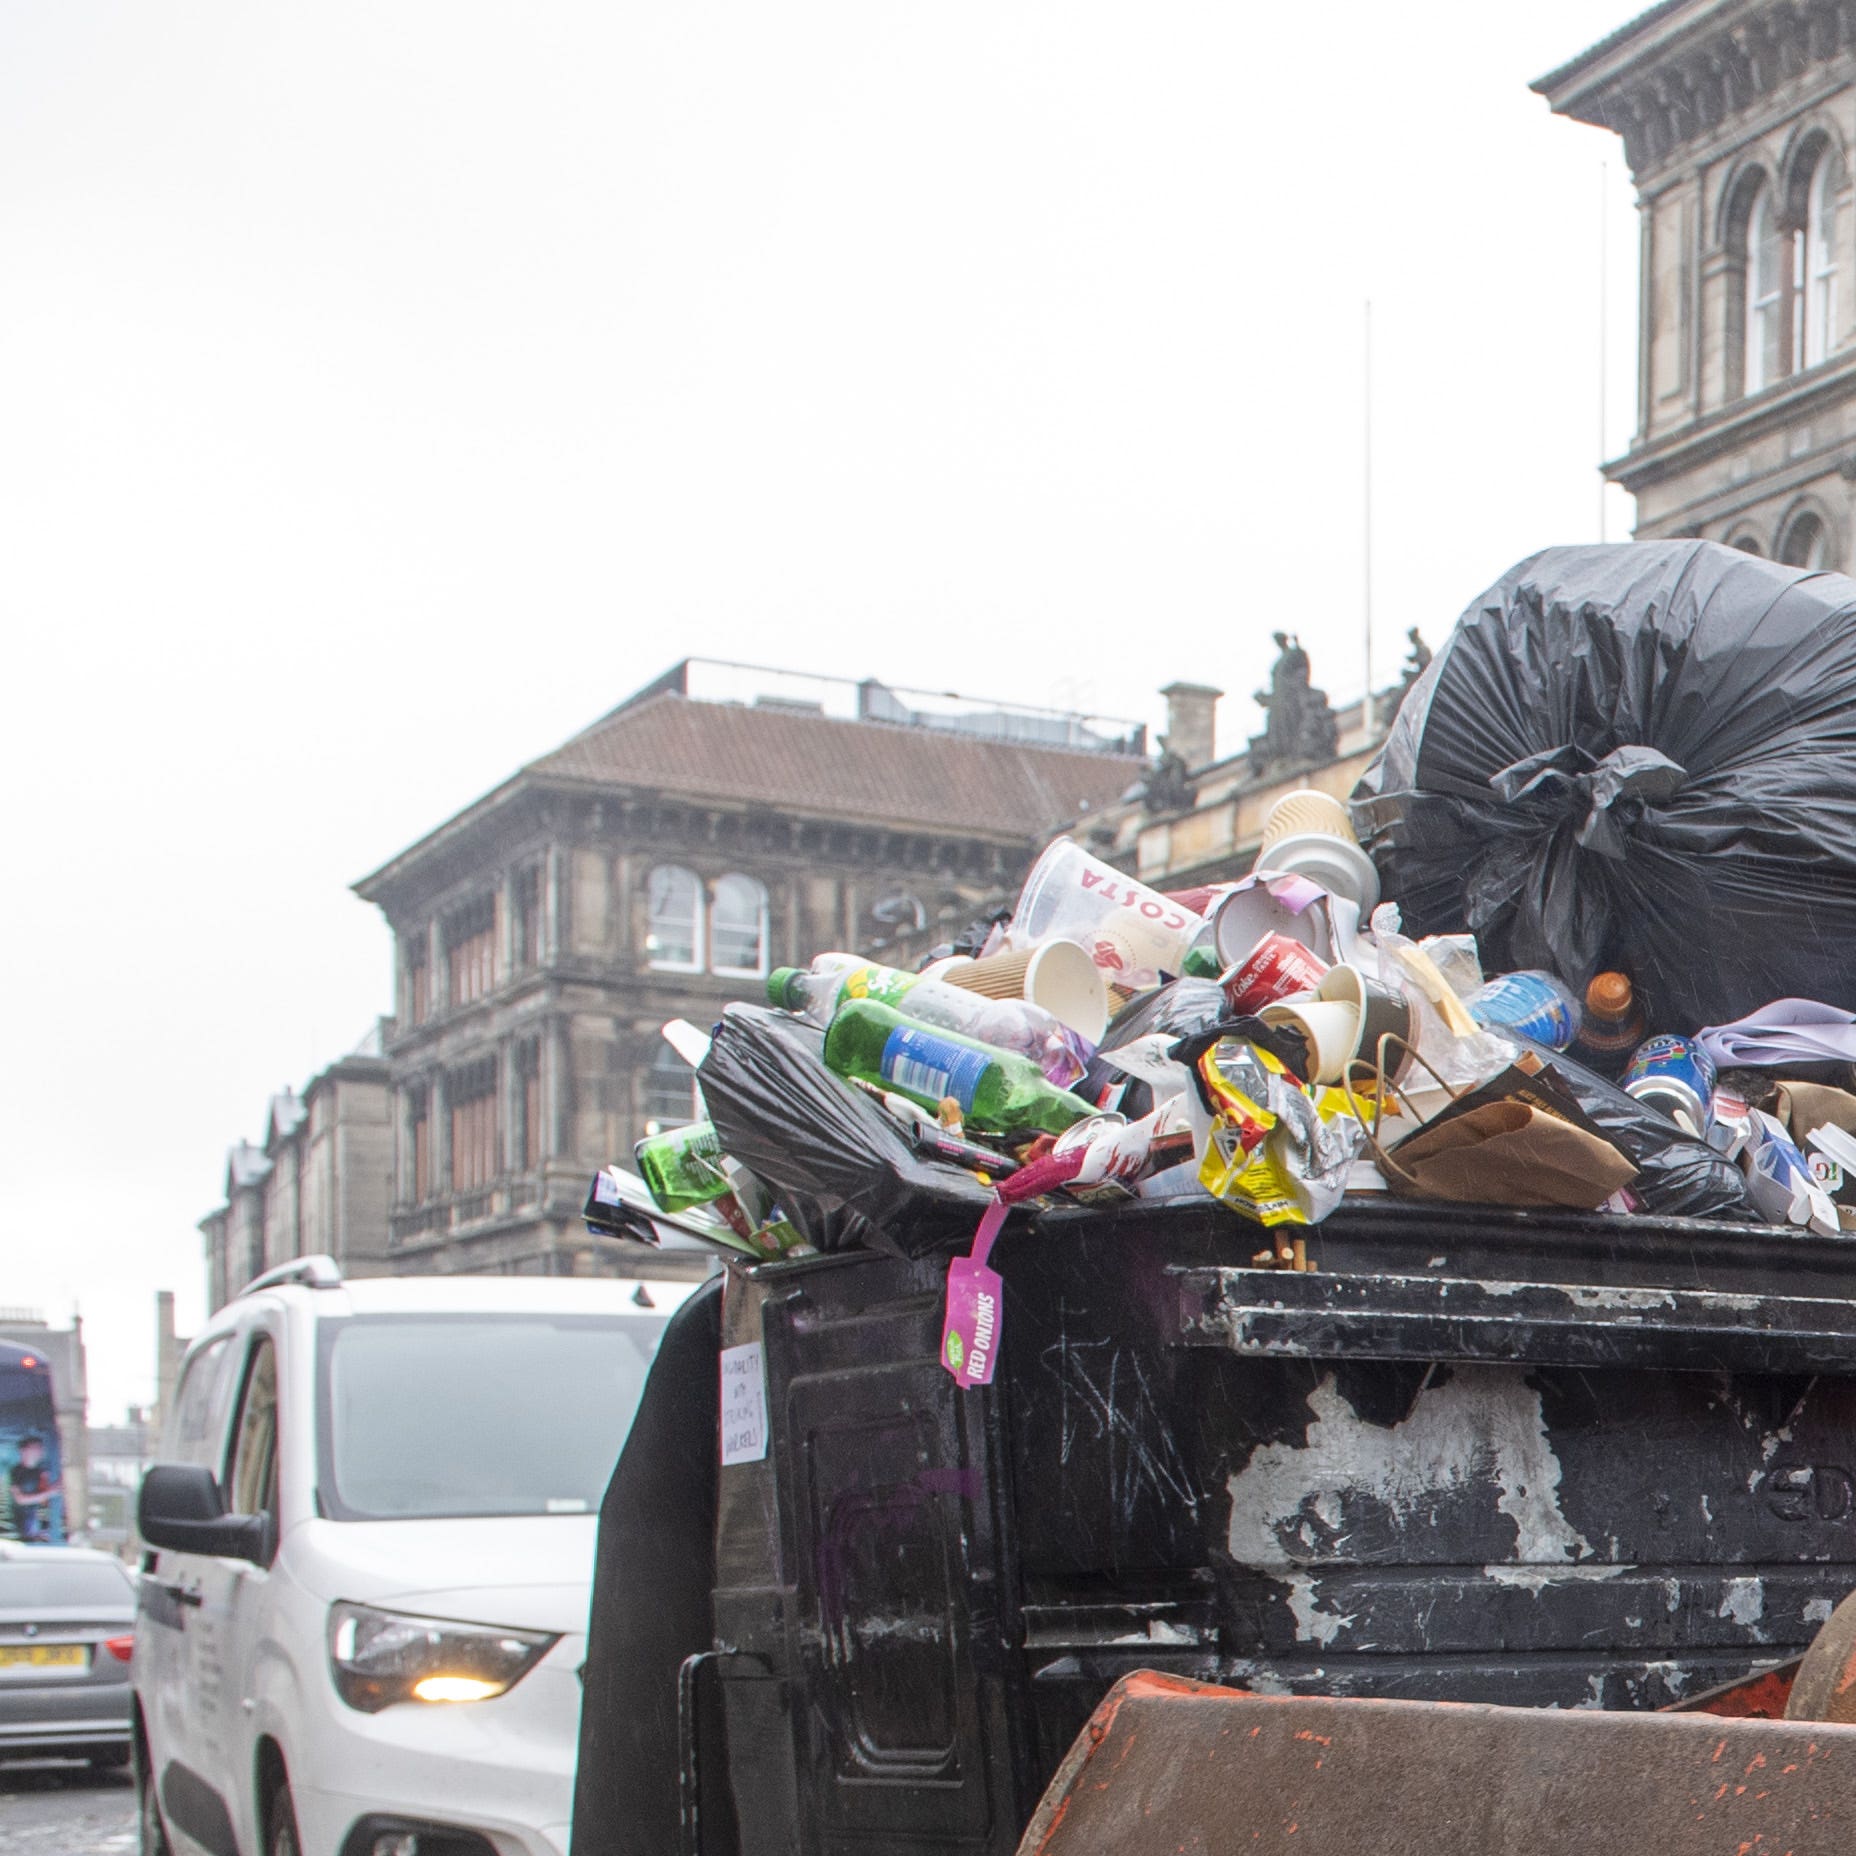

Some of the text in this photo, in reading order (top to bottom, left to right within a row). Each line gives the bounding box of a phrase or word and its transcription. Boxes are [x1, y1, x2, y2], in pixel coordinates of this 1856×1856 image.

[1080, 868, 1186, 930] COSTA
[966, 1291, 996, 1380] RED ONIONS
